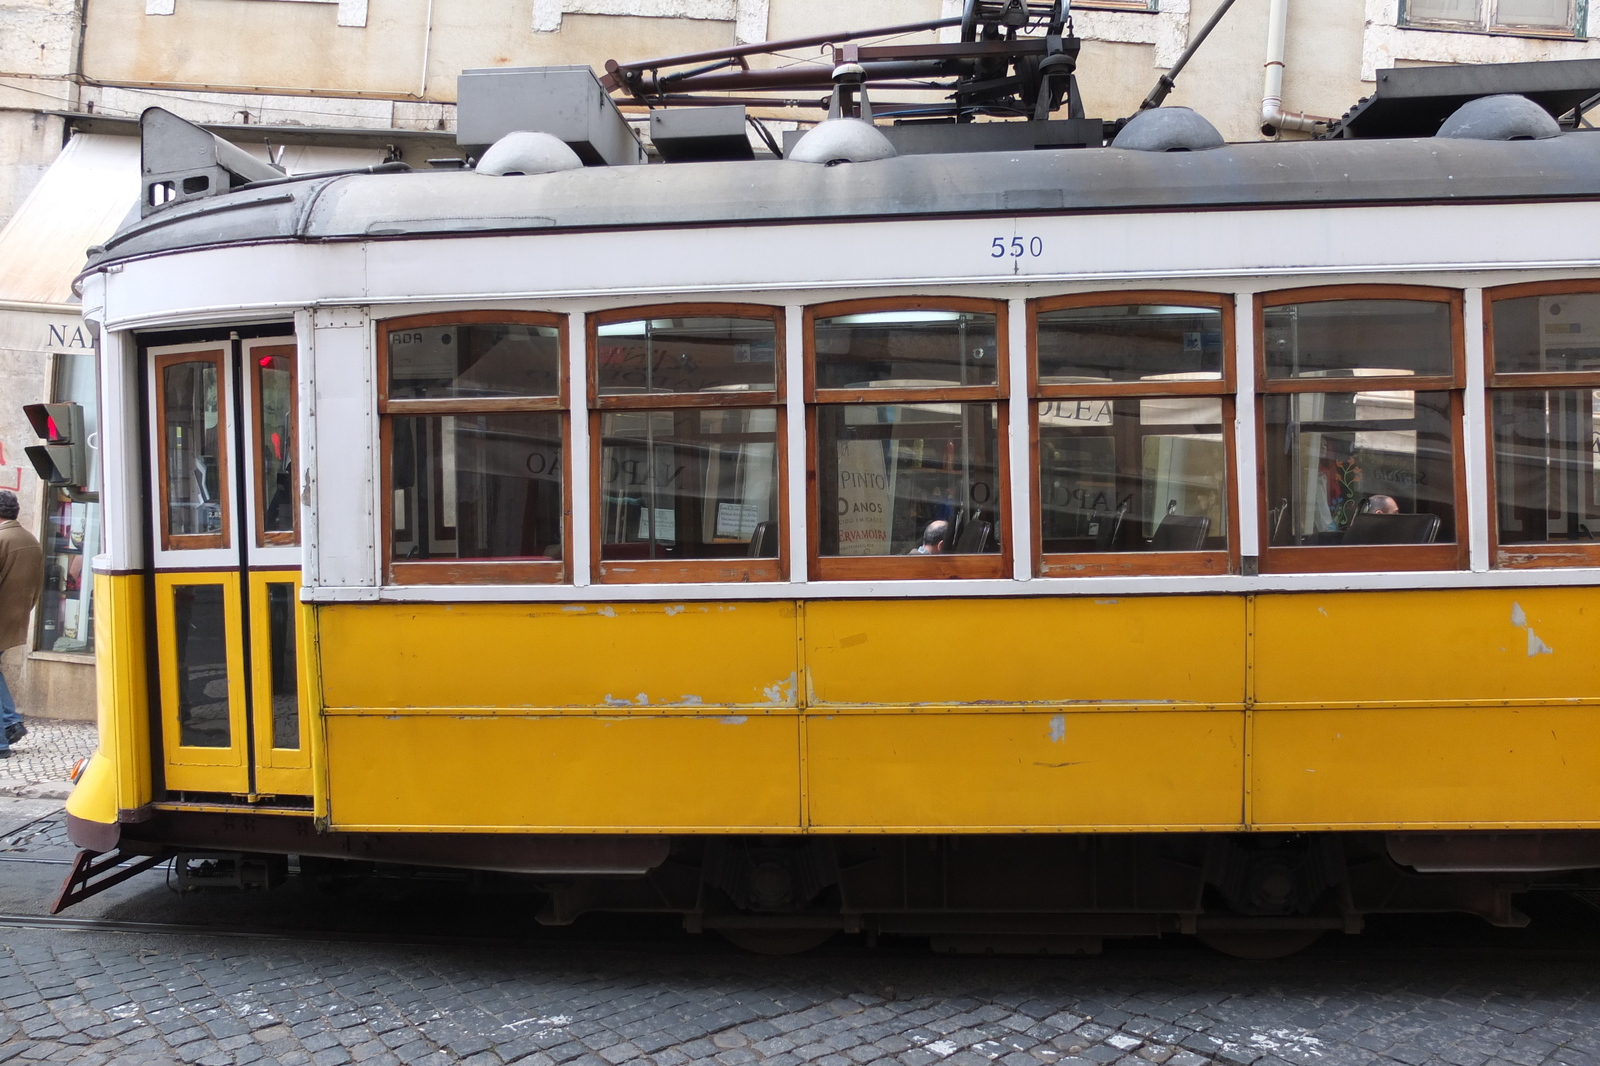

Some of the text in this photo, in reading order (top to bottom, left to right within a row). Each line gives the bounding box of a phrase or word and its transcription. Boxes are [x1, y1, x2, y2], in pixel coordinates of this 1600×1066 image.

[991, 236, 1043, 258] 550
[47, 324, 95, 349] NA
[841, 470, 885, 491] PINTO
[853, 502, 883, 514] ANOS
